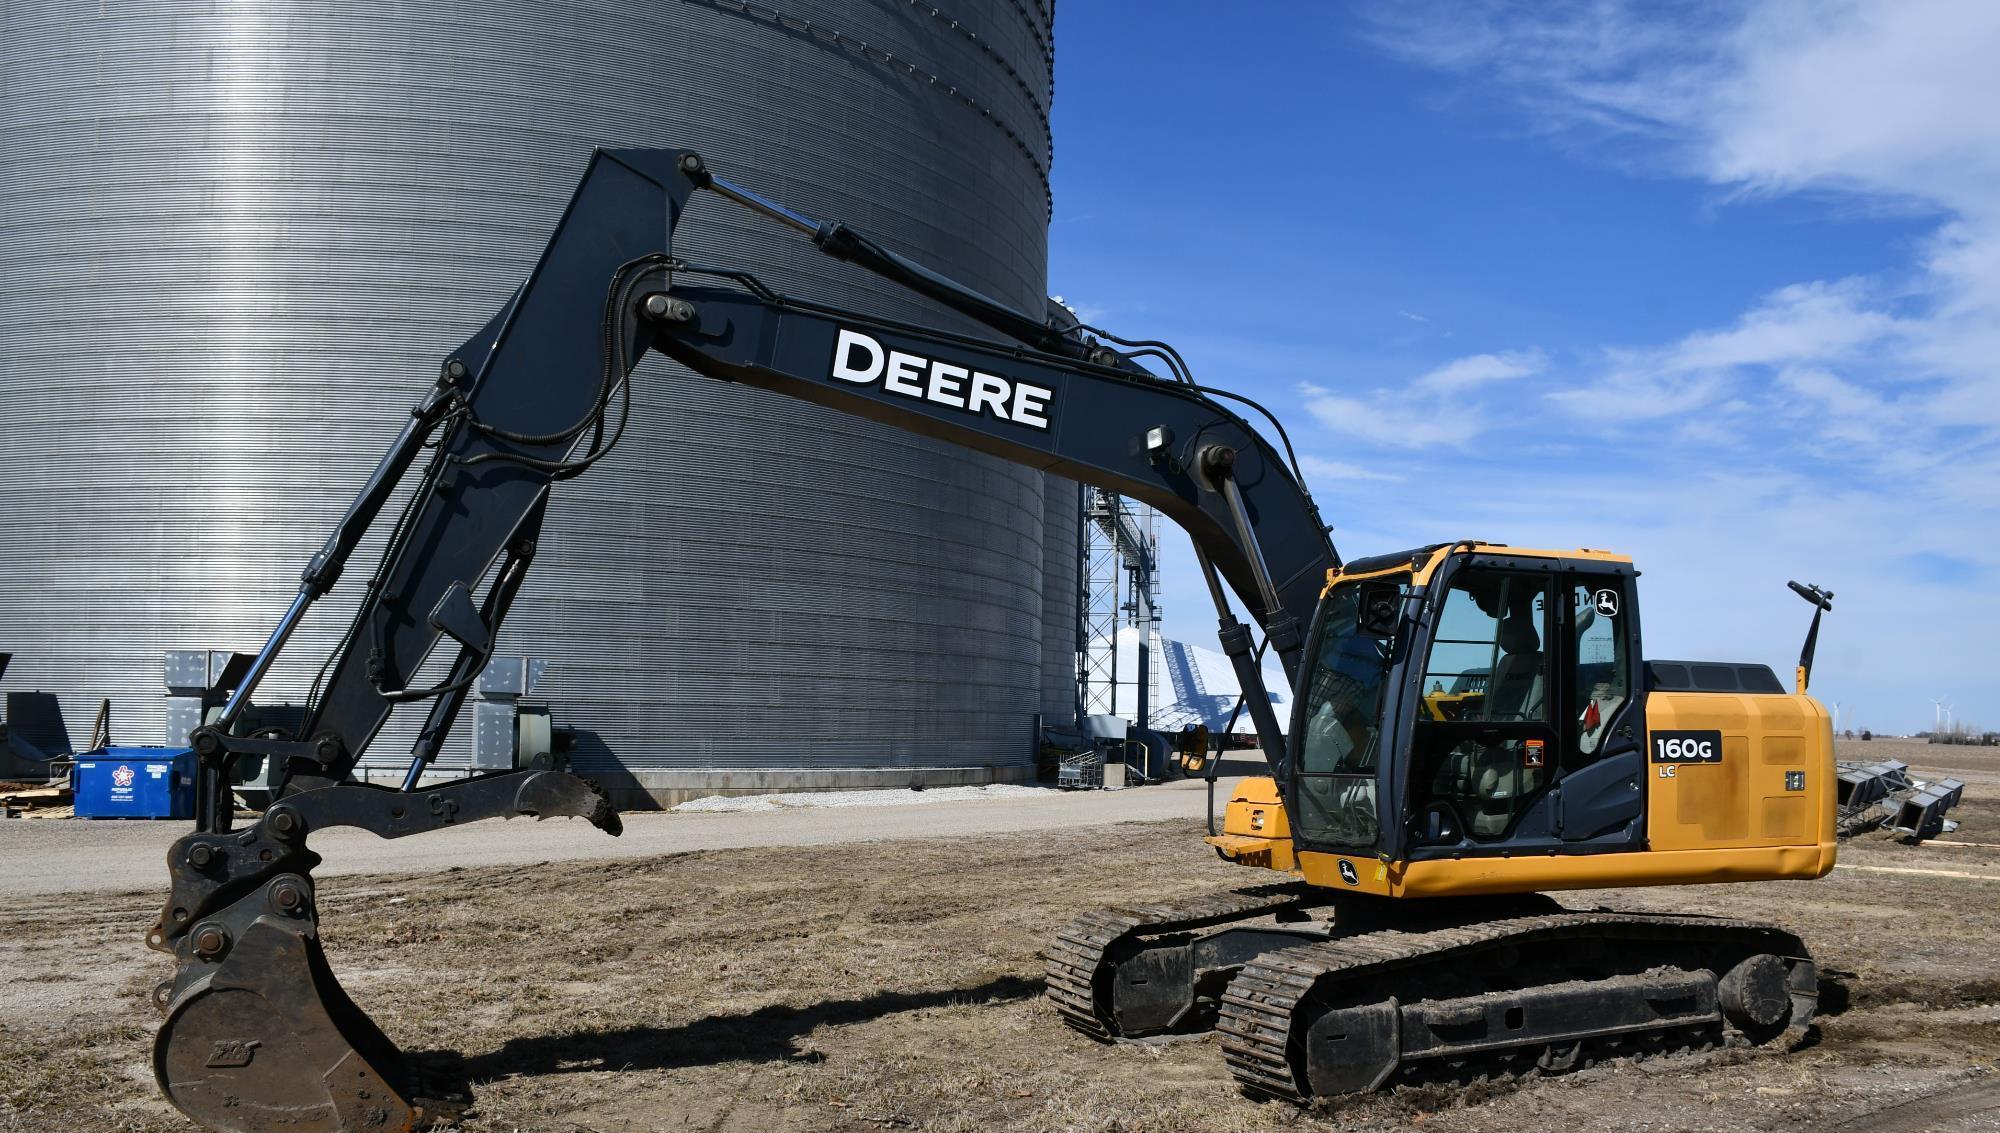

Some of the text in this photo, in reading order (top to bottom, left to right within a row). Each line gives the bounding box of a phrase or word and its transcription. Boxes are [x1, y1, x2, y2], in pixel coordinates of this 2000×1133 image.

[832, 328, 1052, 429] DEERE
[1657, 738, 1712, 759] 160G
[1658, 765, 1675, 778] LC
